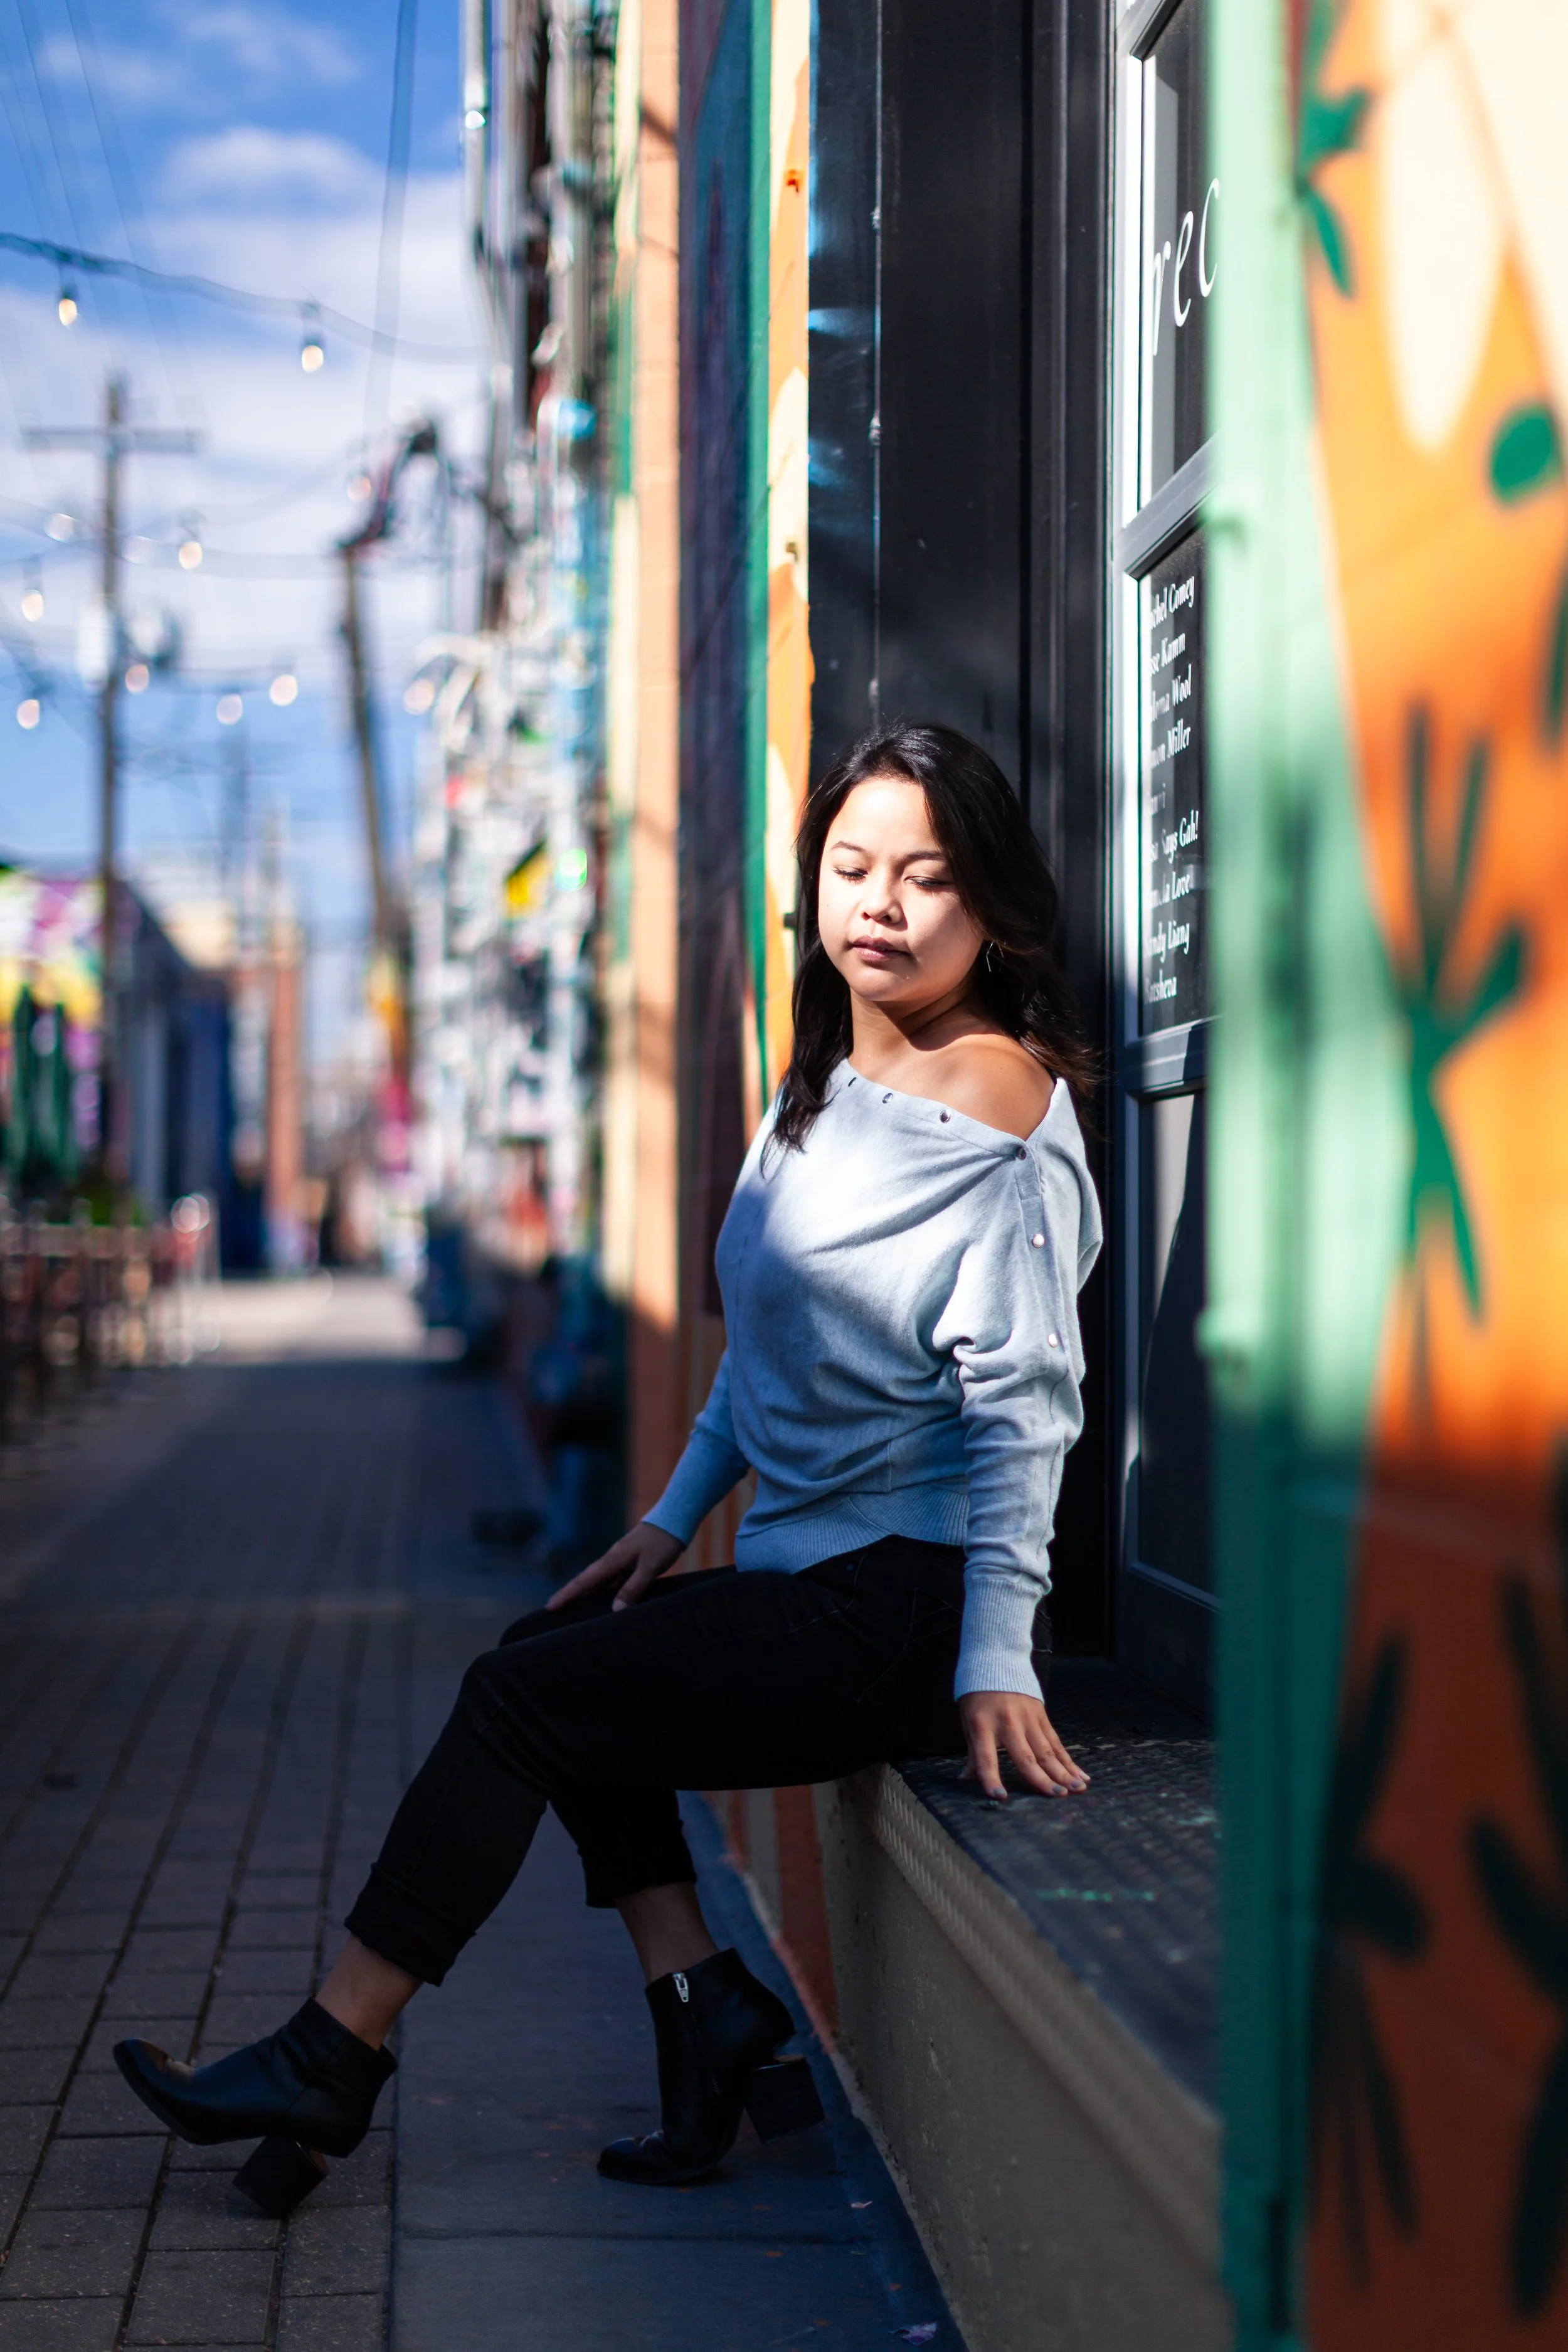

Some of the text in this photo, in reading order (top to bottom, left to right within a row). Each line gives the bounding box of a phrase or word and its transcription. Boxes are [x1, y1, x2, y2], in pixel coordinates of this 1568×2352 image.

[1168, 576, 1195, 613] Comey
[1172, 664, 1192, 706] Wool
[1167, 718, 1191, 758] Miller
[1179, 809, 1199, 847] Gah!
[1172, 871, 1190, 900] Love
[1168, 920, 1190, 955] Liang
